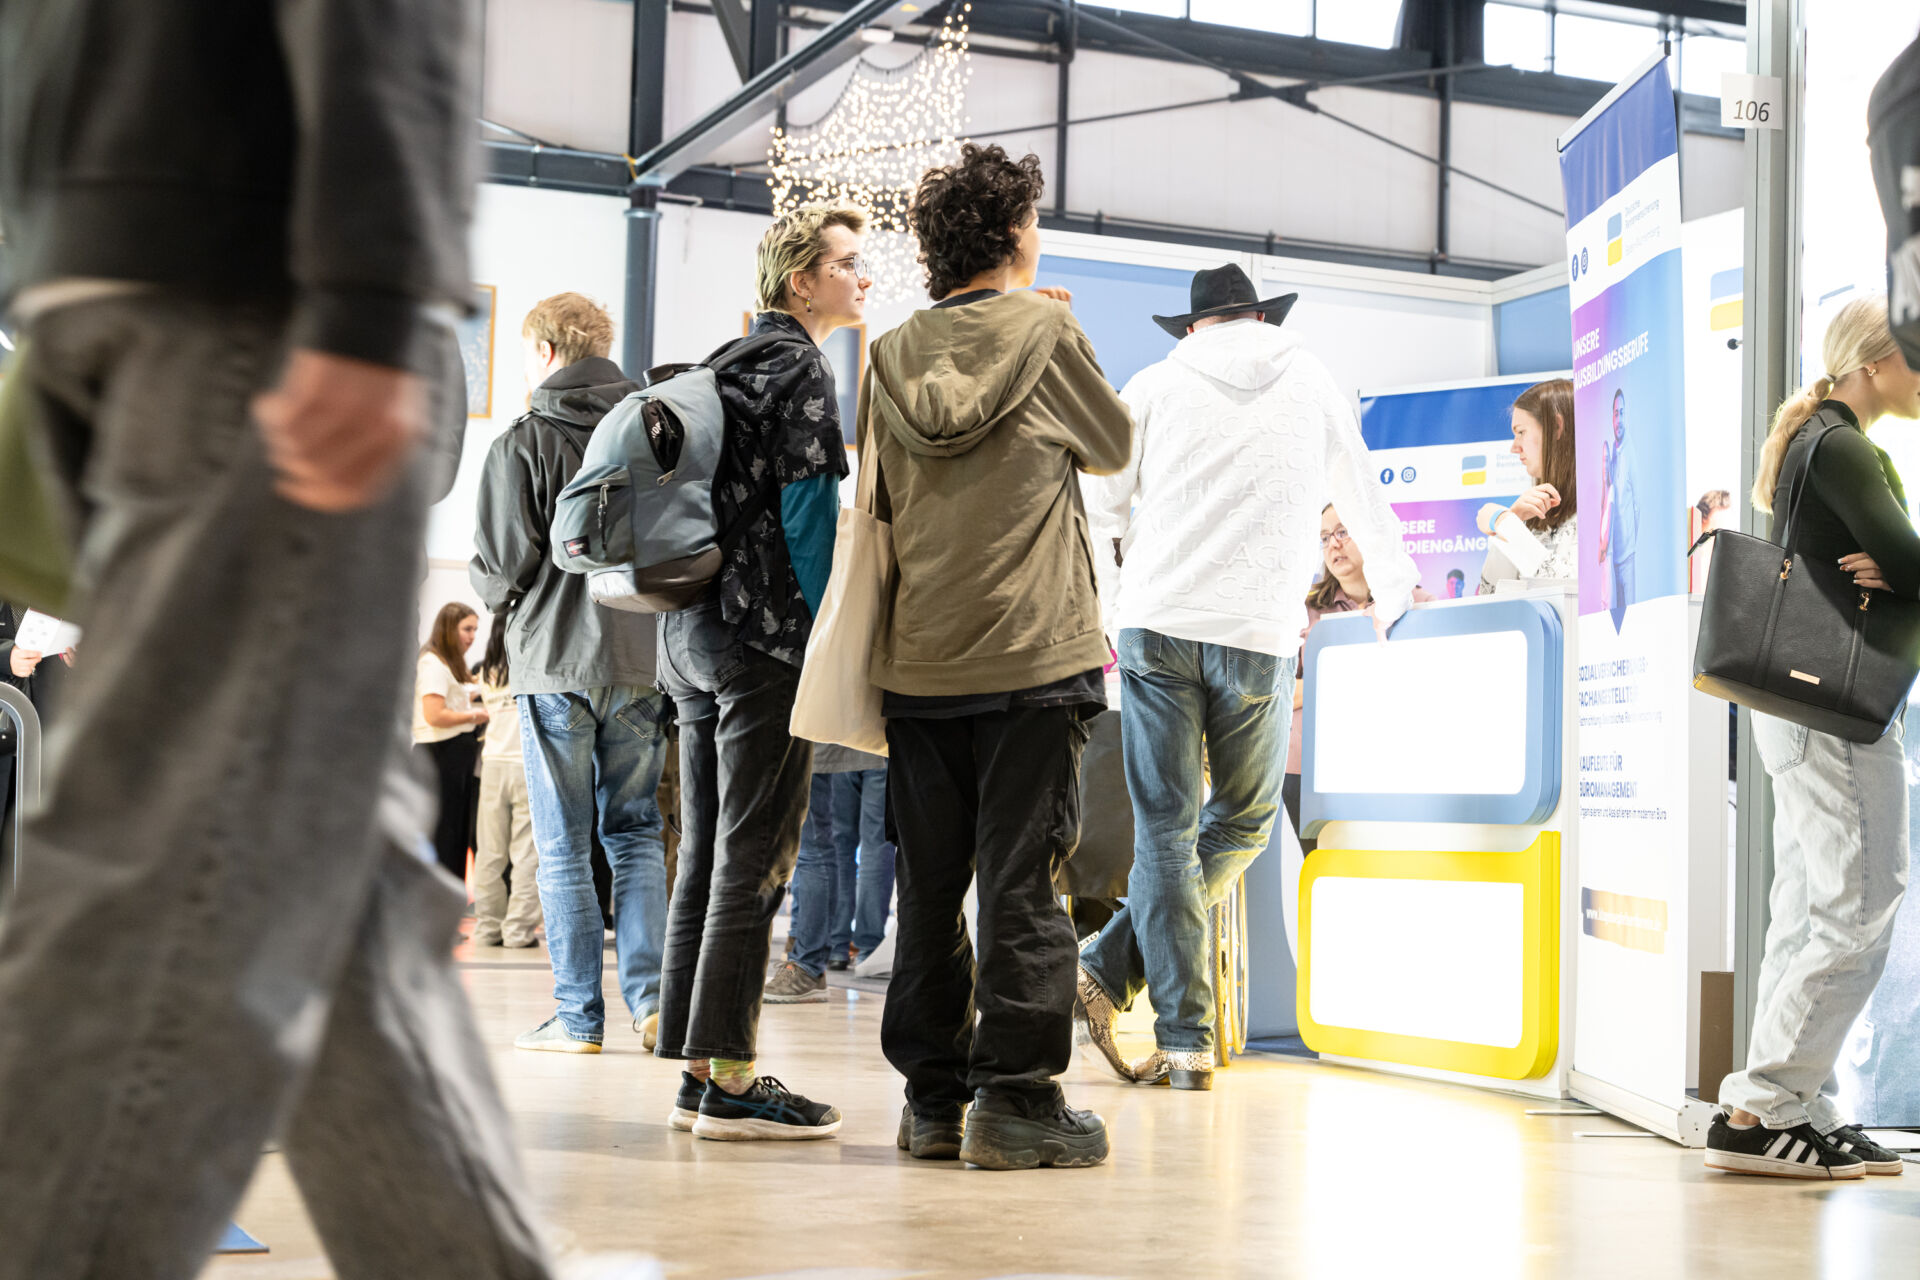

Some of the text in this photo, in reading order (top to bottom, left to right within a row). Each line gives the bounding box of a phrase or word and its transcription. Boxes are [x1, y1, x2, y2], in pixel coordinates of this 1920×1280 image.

[1733, 100, 1770, 122] 106
[1574, 328, 1600, 361] UNSERE
[1574, 330, 1649, 393] AUSBILDUNGSBERUFE
[1399, 519, 1436, 535] SERE
[1402, 535, 1488, 555] DIENGÄNG
